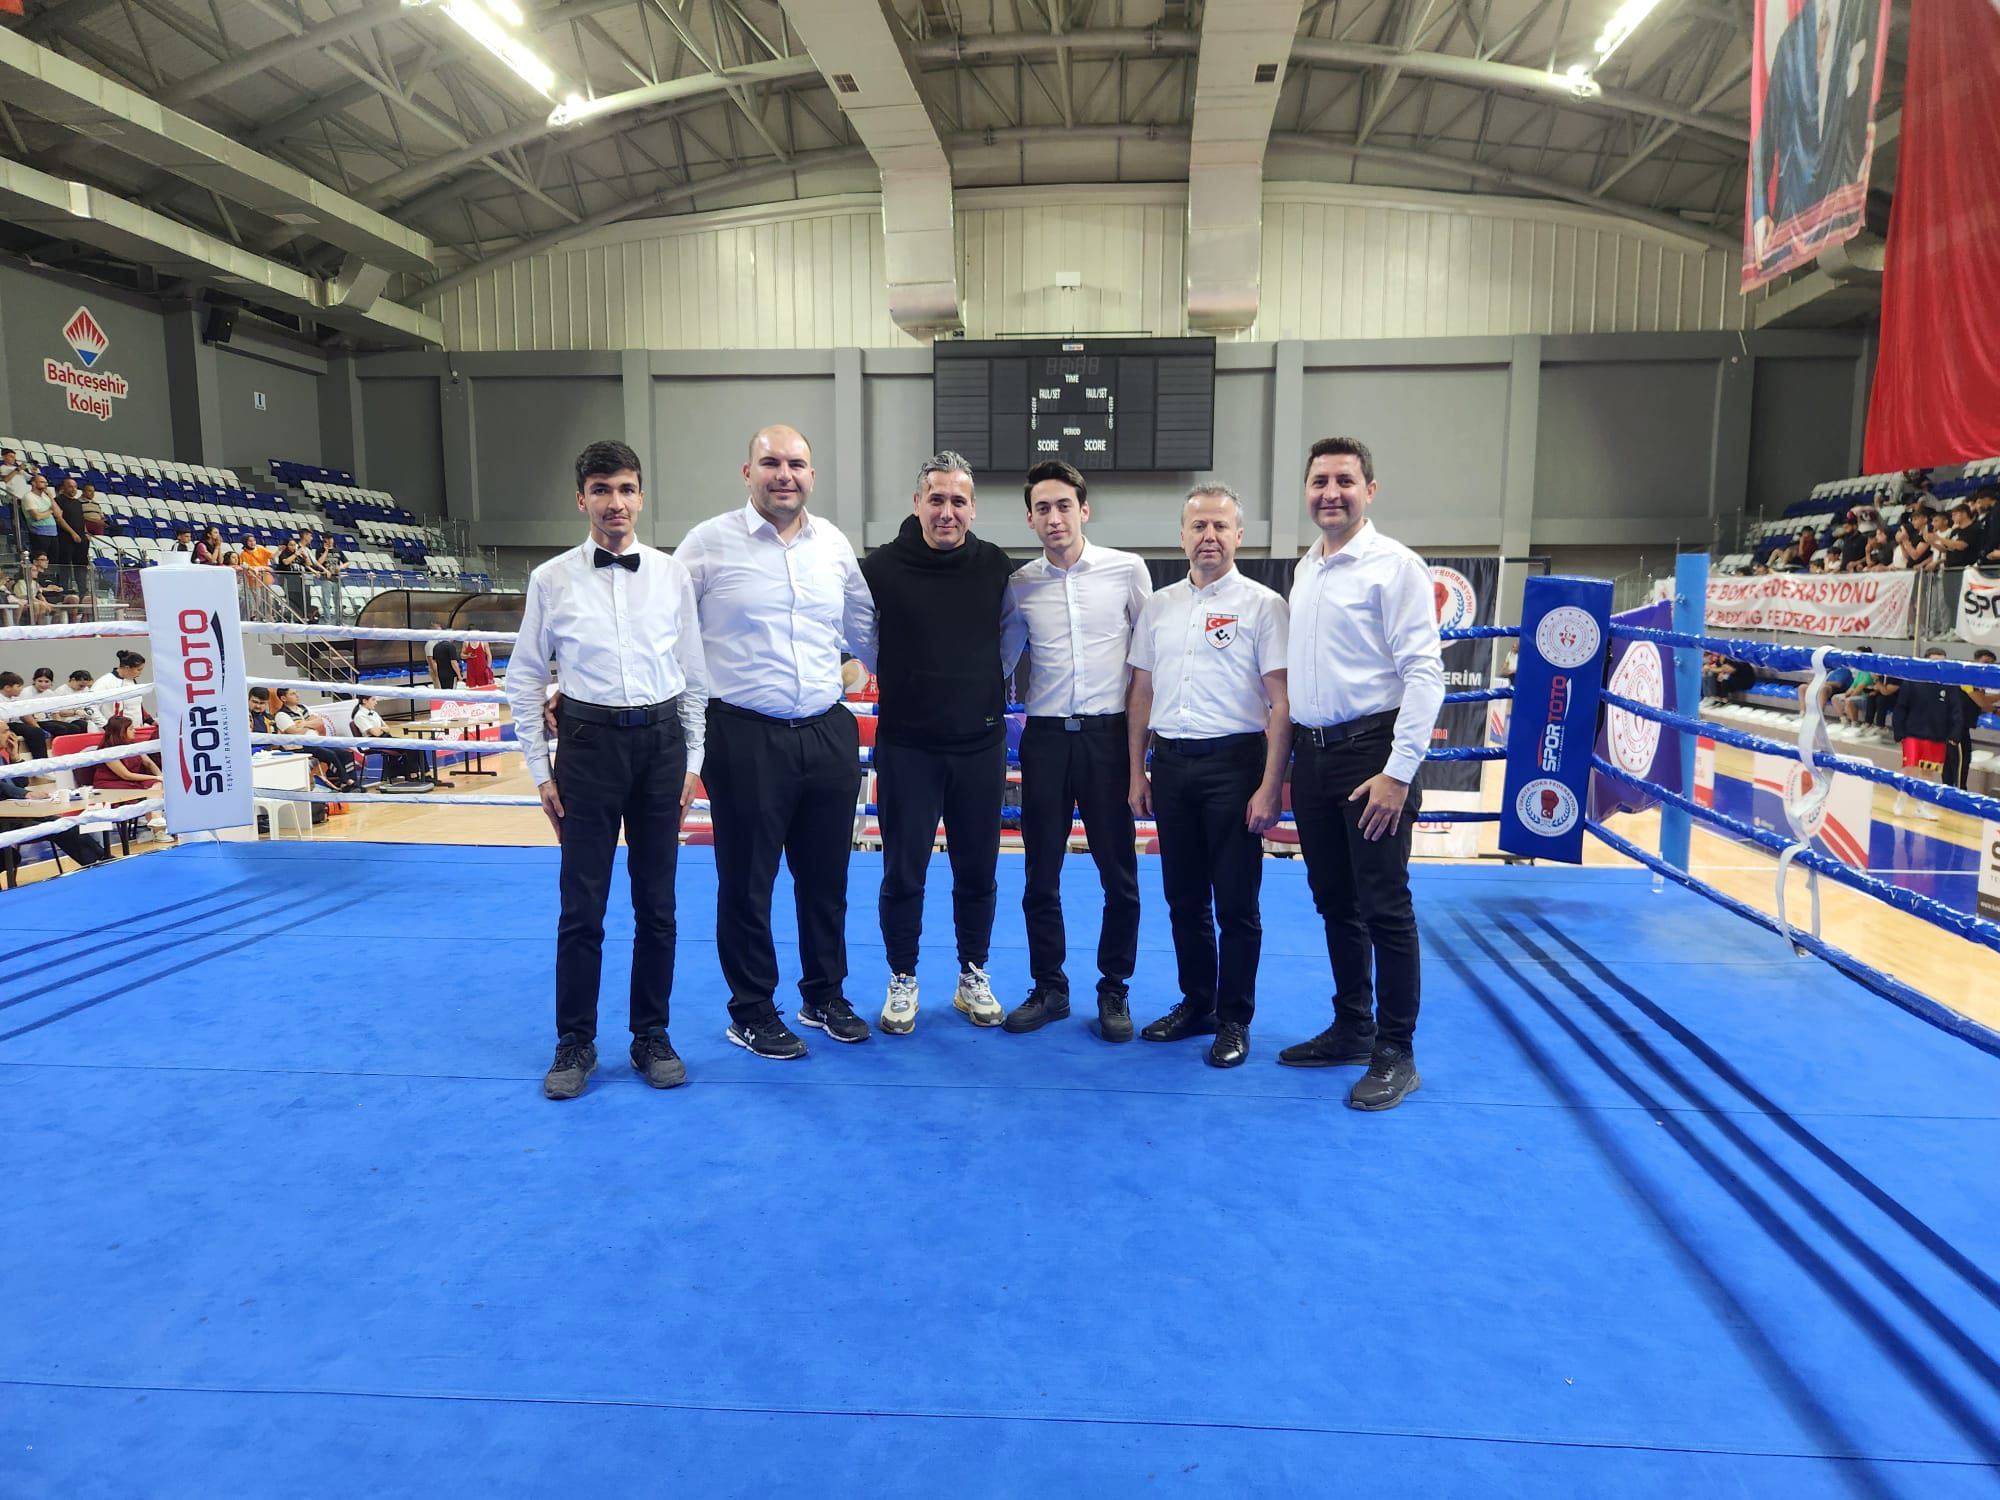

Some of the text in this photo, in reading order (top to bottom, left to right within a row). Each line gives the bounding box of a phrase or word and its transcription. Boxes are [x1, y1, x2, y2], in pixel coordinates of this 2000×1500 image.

[47, 363, 126, 395] Bahçeşehir
[1065, 374, 1080, 384] TIME
[69, 392, 110, 419] Koleji
[1037, 440, 1060, 452] SCORE
[1083, 440, 1107, 452] SCORE
[178, 609, 224, 796] SPOR TOTO
[1547, 675, 1567, 722] TOTO
[1542, 723, 1561, 772] SPOR
